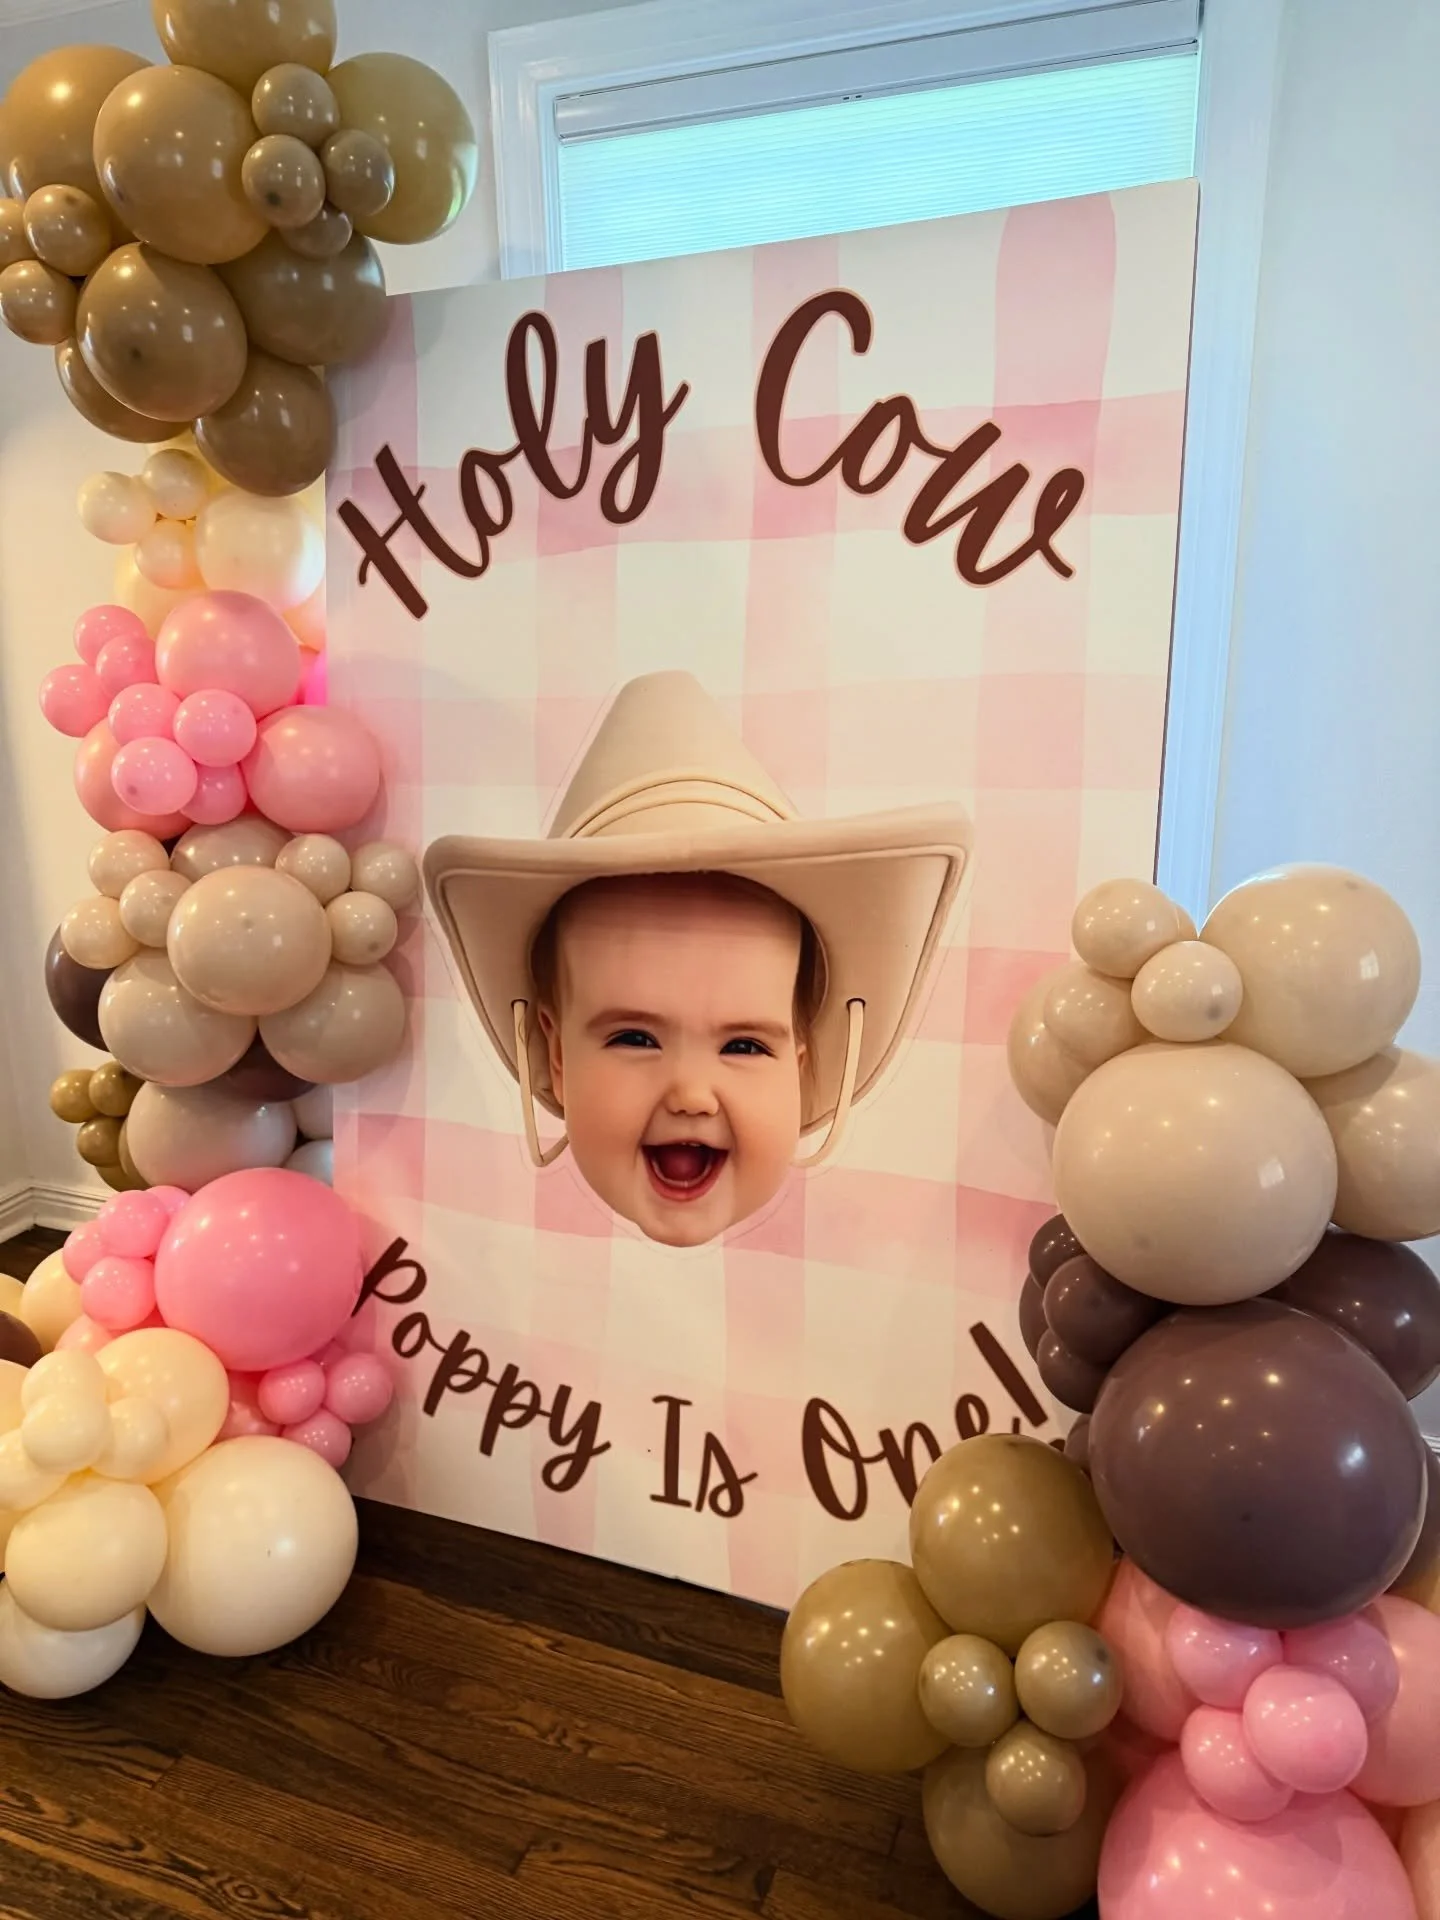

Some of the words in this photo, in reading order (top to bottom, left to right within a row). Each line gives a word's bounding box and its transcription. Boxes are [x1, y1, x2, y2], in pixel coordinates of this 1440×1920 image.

[336, 310, 690, 620] Holy
[754, 289, 1086, 587] Cow
[351, 1236, 612, 1493] Poppy
[650, 1395, 758, 1518] Is
